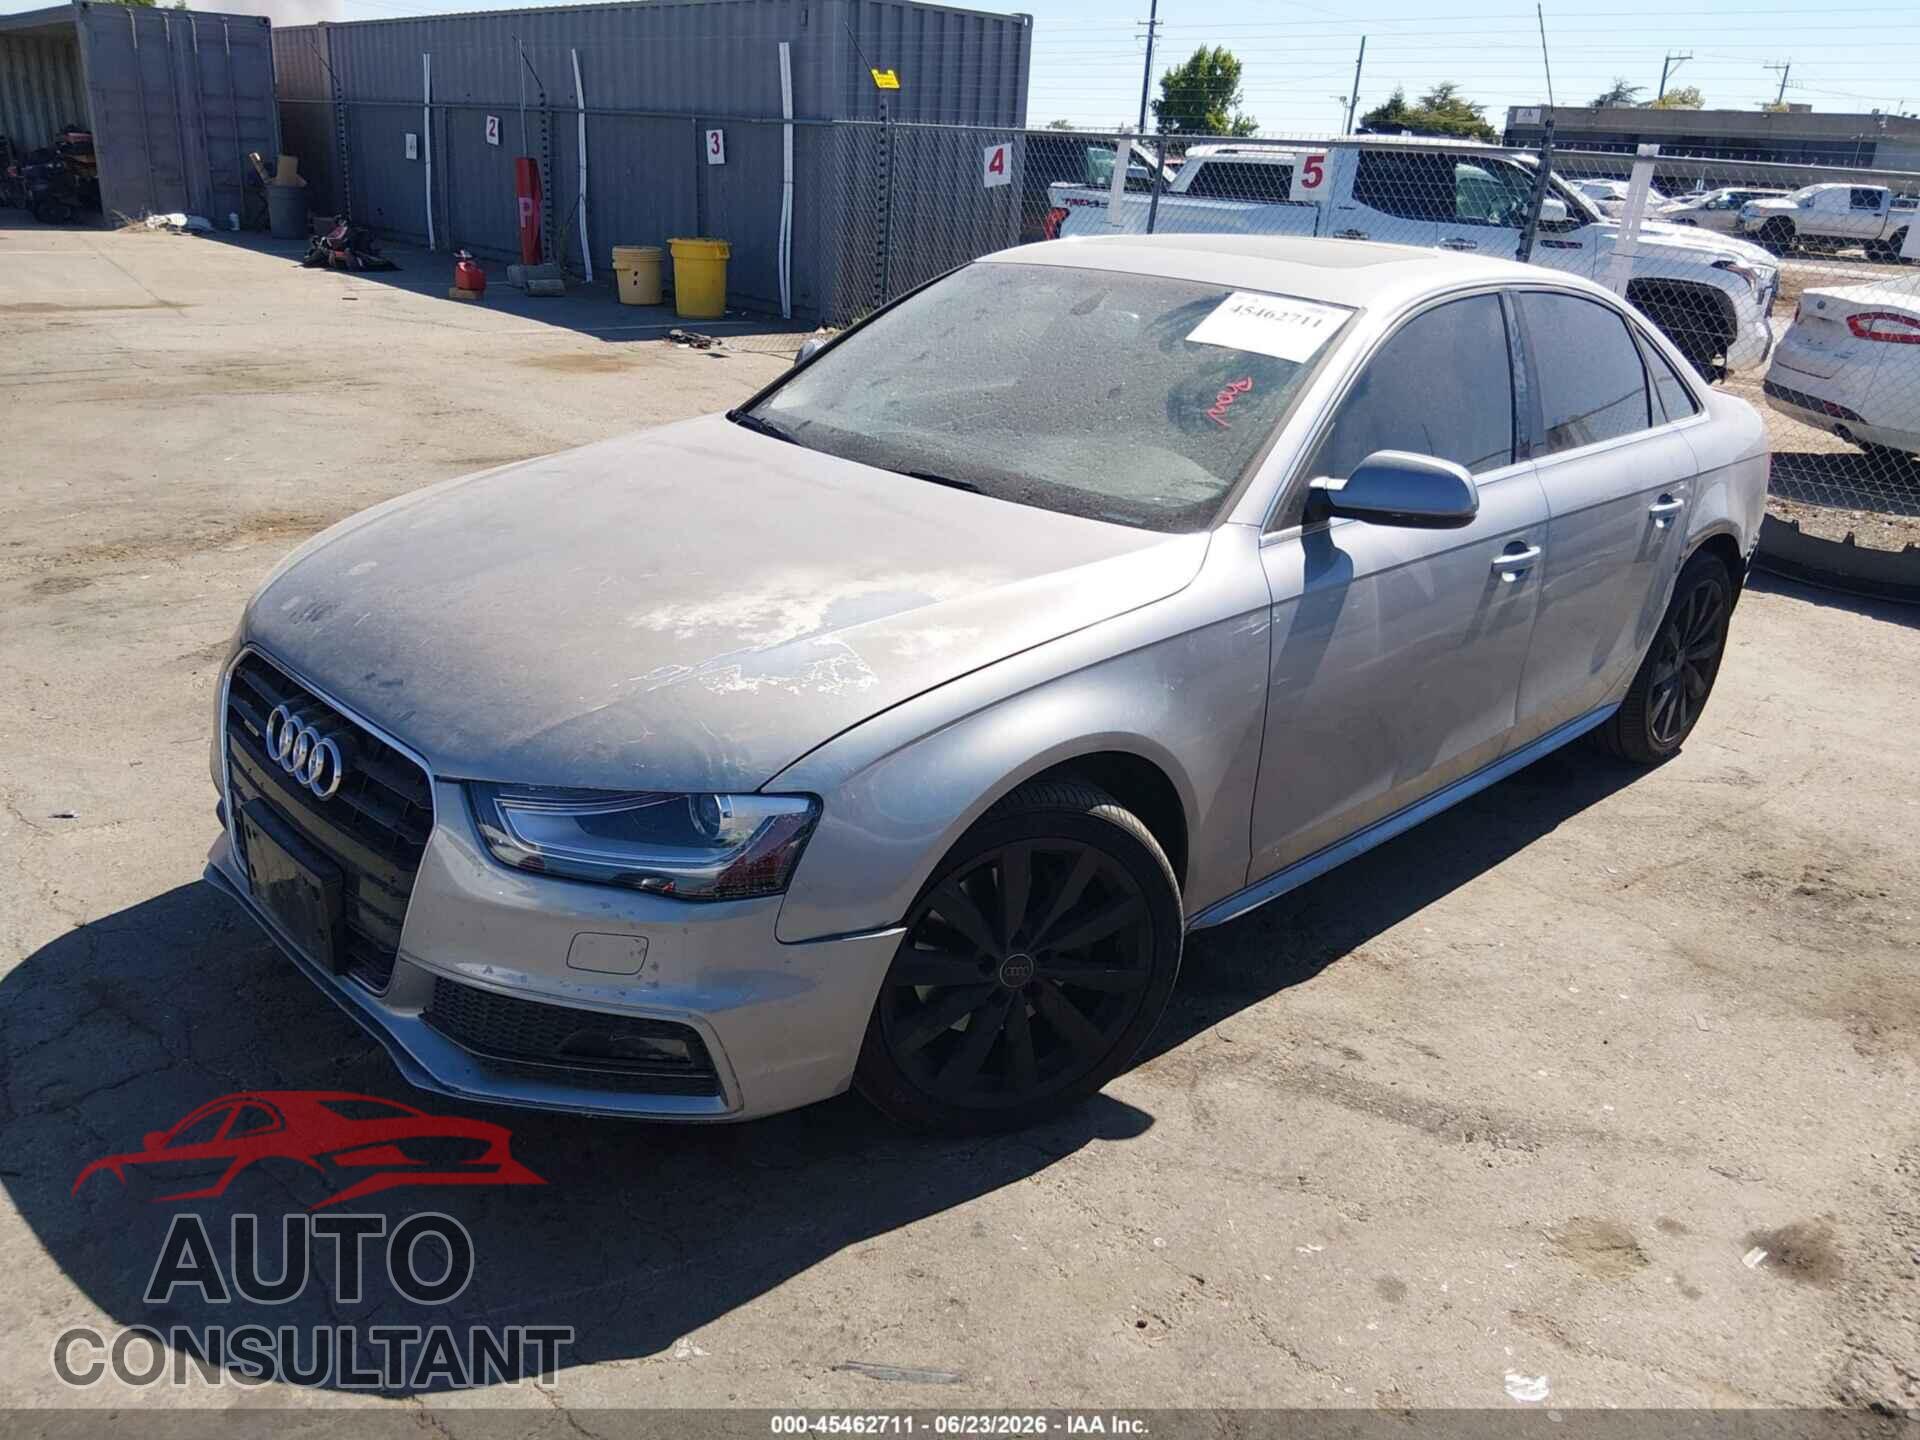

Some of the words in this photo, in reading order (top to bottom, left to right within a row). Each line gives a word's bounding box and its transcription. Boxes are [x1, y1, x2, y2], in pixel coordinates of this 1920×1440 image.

[488, 118, 496, 138] 2
[710, 131, 720, 155] 3
[988, 147, 1004, 176] 4
[1301, 155, 1325, 189] 5
[1229, 303, 1323, 328] 45462711
